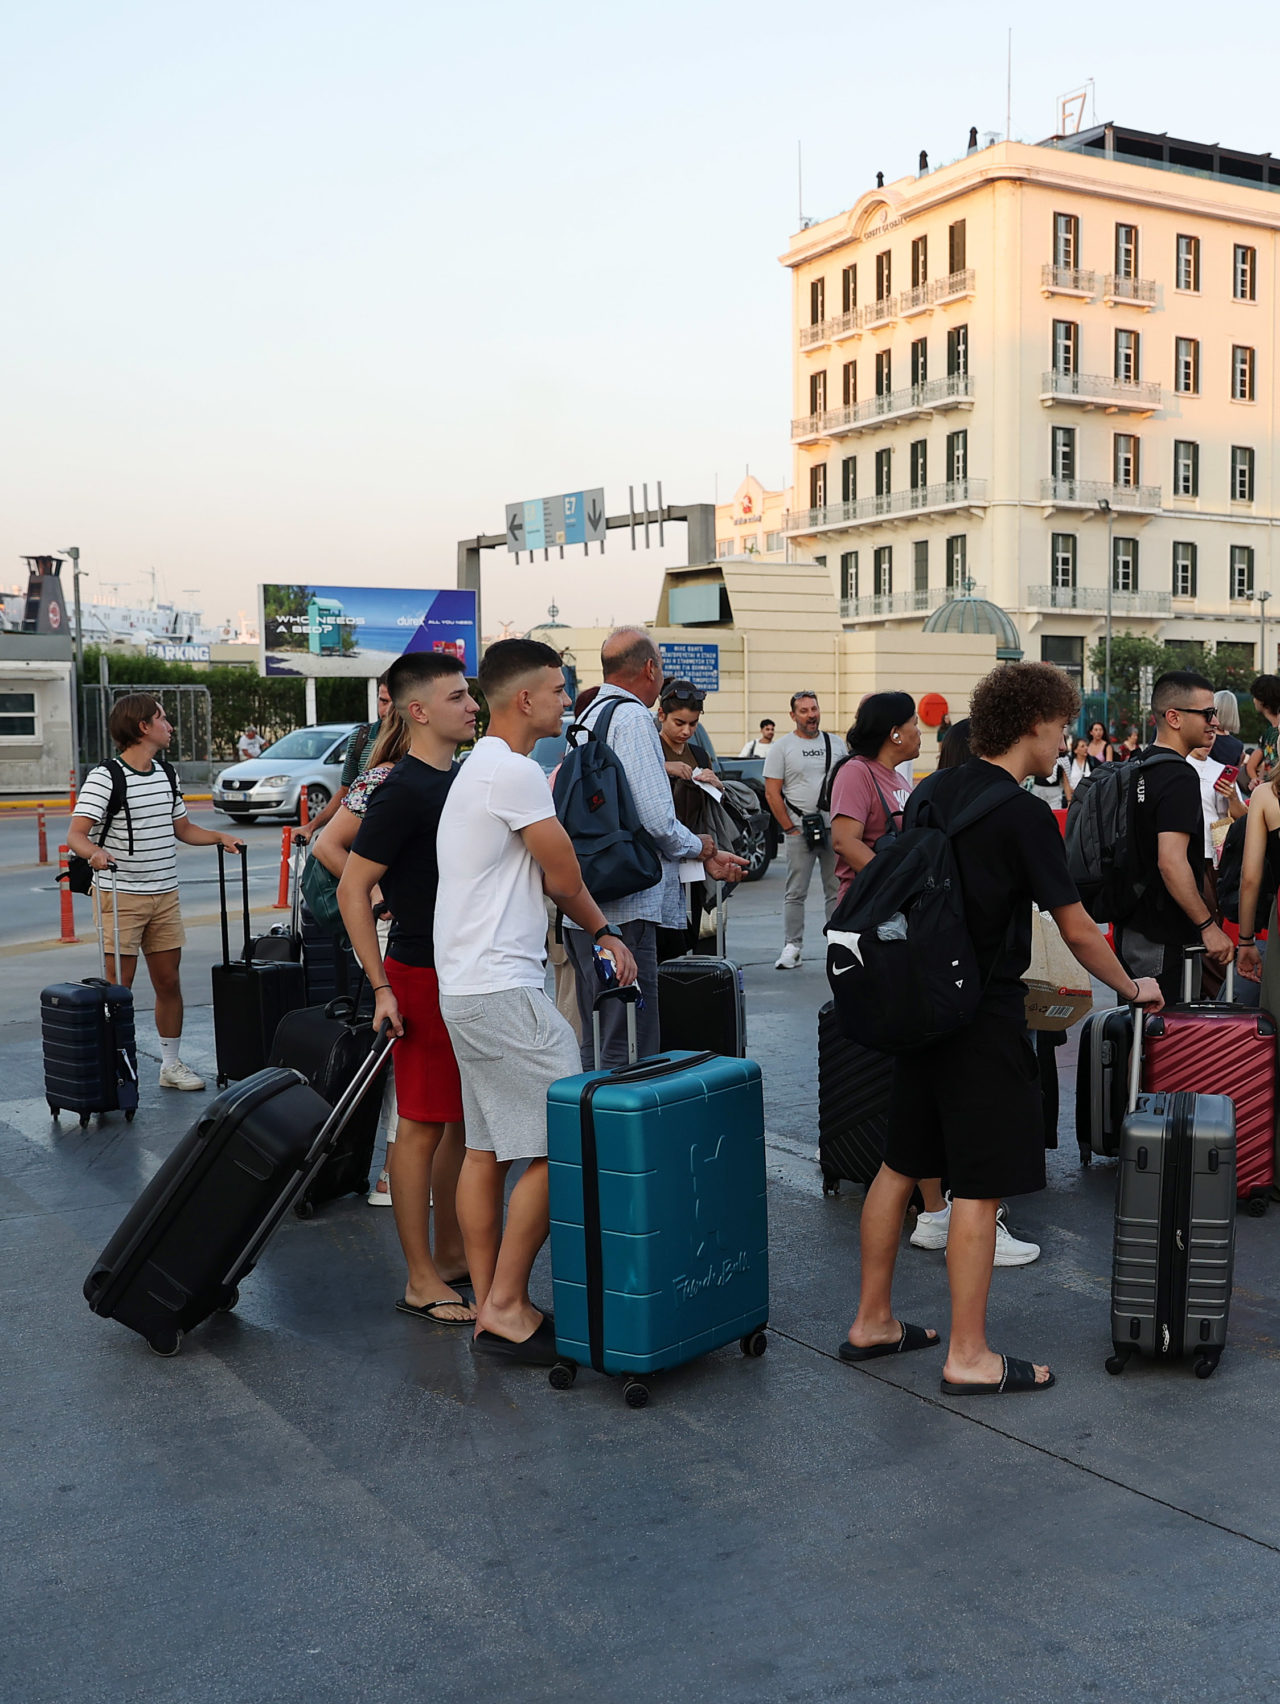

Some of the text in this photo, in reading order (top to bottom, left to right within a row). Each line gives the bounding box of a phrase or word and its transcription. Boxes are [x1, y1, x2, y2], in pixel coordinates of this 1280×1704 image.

[564, 497, 577, 515] E7
[276, 616, 366, 625] WHO NEEDS
[397, 616, 426, 627] durex
[276, 625, 333, 634] A BED?
[147, 645, 209, 661] PARKING
